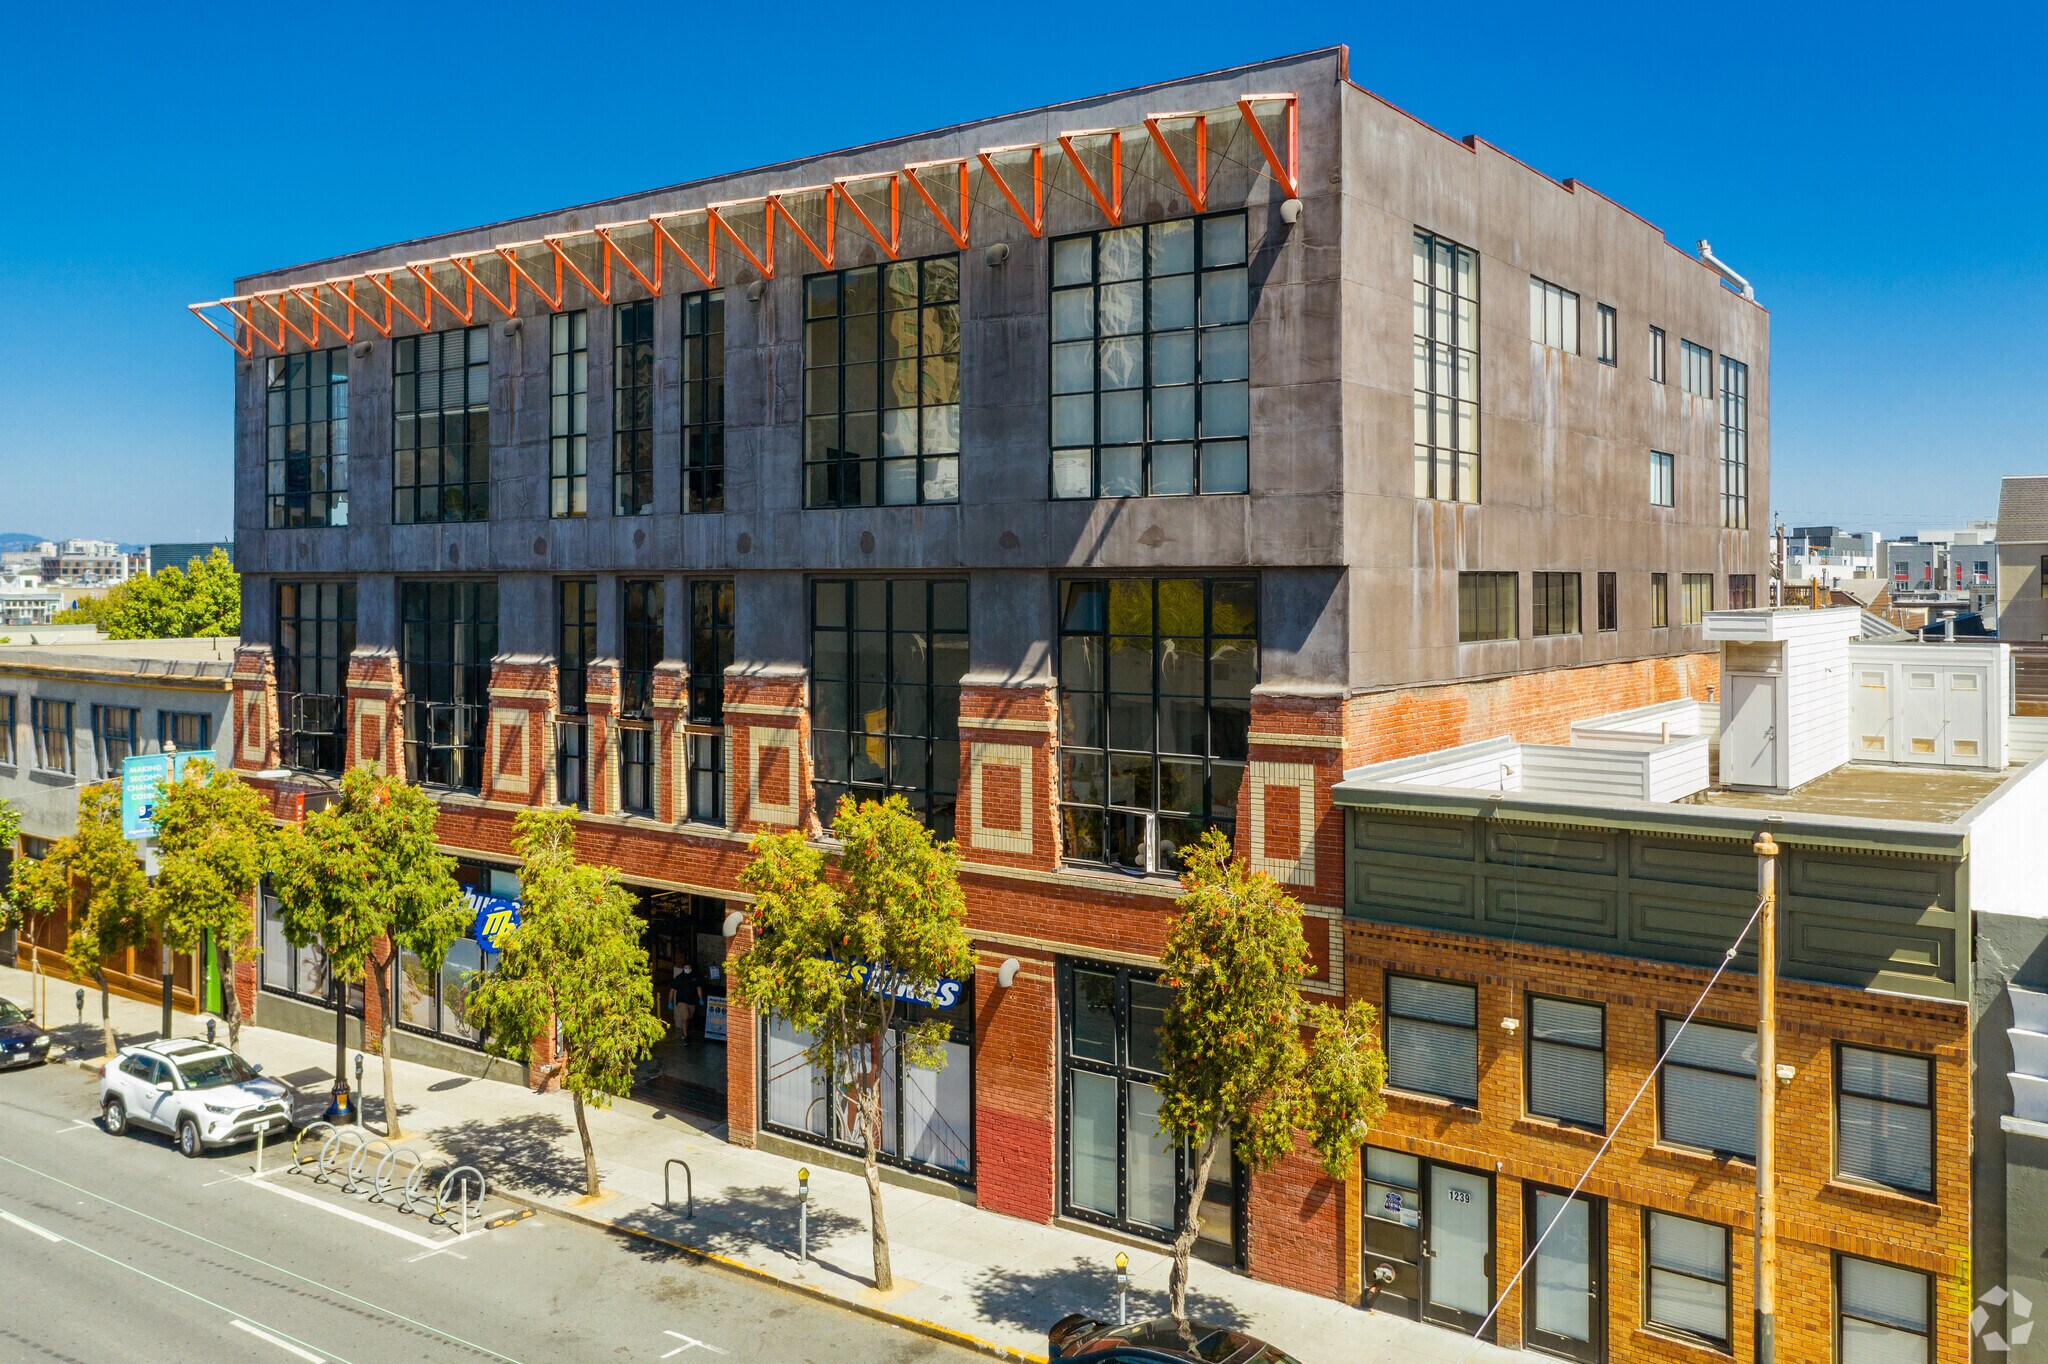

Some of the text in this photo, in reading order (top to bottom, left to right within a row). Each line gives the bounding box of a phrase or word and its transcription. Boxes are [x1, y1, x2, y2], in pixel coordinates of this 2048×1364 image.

[129, 764, 162, 774] MAKING
[127, 782, 158, 792] CHANC
[131, 792, 156, 801] COUN
[1449, 1191, 1470, 1204] 1239
